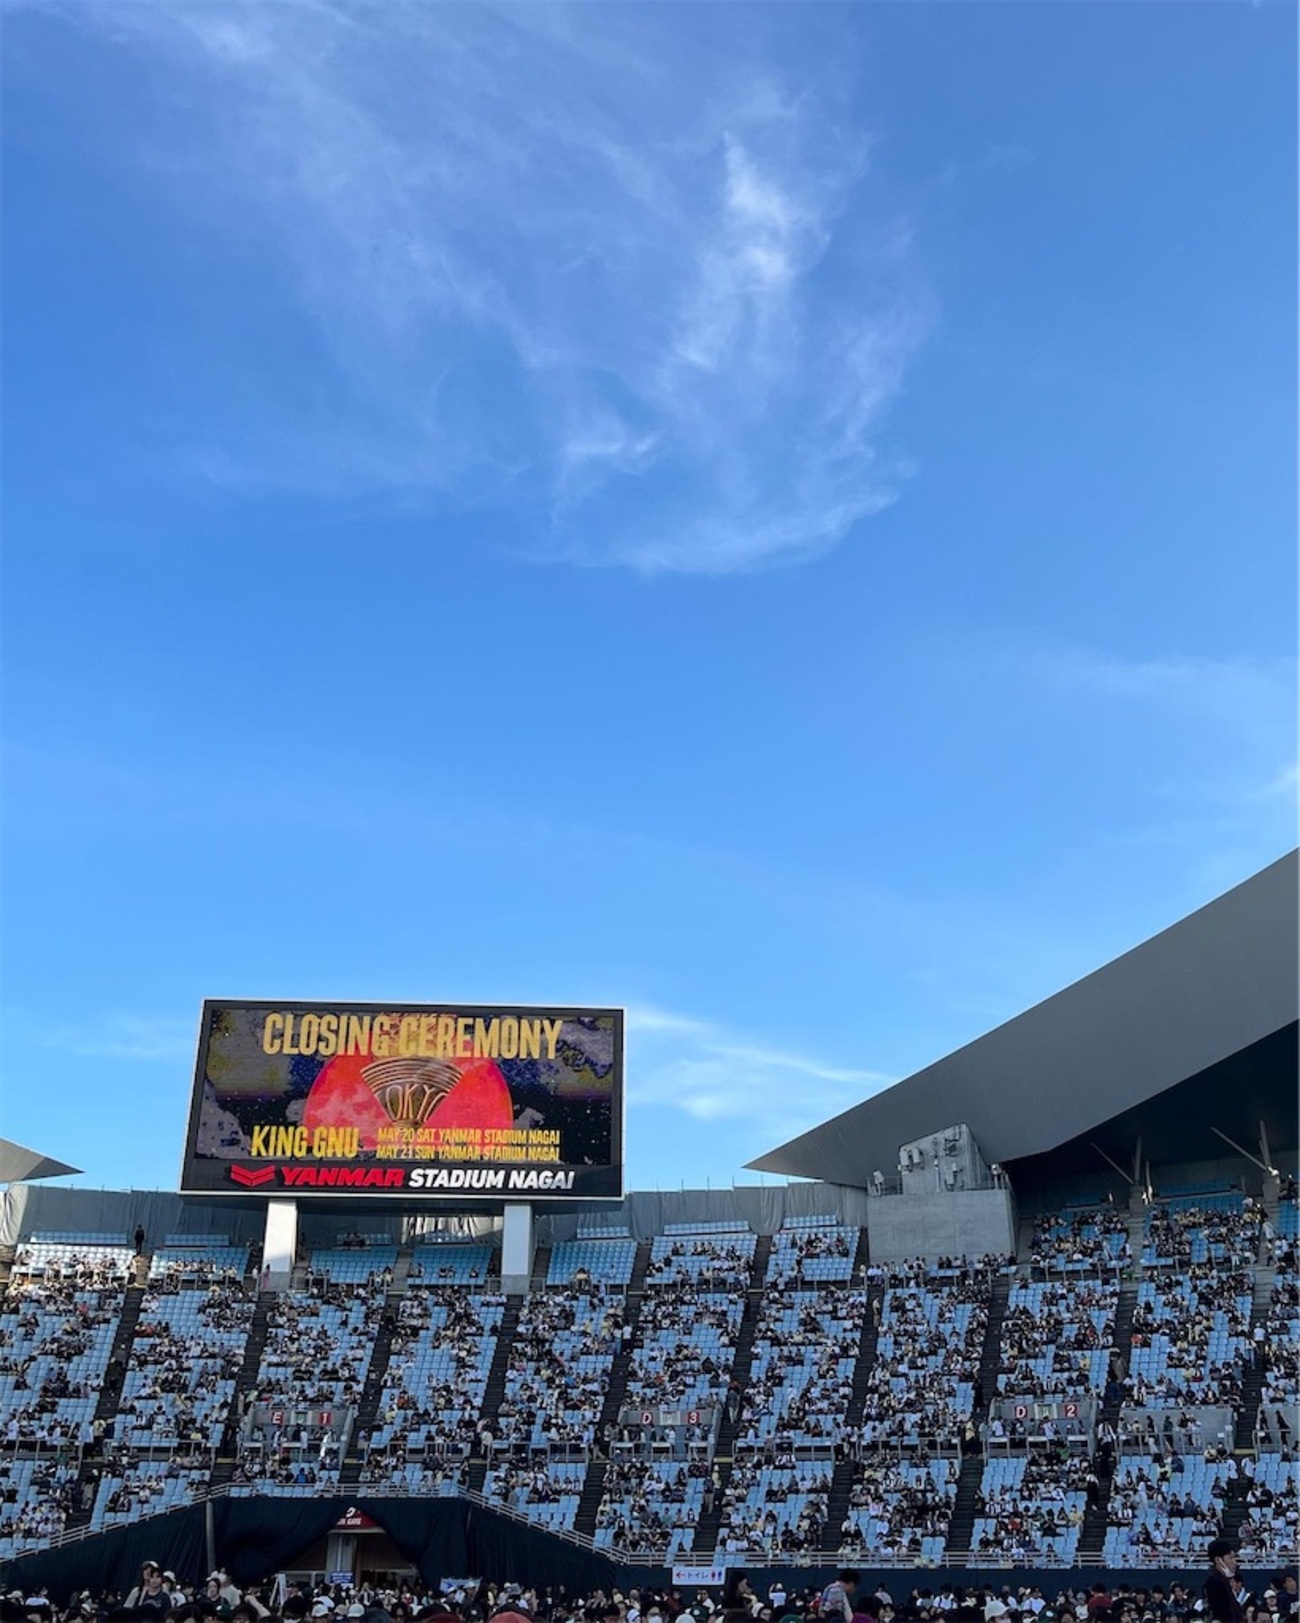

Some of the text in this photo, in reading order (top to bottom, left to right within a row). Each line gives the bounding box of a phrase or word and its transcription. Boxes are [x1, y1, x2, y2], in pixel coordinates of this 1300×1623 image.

[263, 1012, 563, 1060] CLOSING CEREMONY
[250, 1125, 359, 1158] KING GNU
[377, 1128, 561, 1145] MAY 20 SAT YANMAR STADIUM NAGAI
[375, 1145, 398, 1159] MAY
[414, 1146, 435, 1160] SUN
[438, 1145, 481, 1161] YANMAR
[482, 1146, 527, 1161] STADIUM
[528, 1147, 560, 1162] NAGAI
[281, 1166, 575, 1190] YANMAR STADIUM NAGAI
[272, 1411, 283, 1424] E
[642, 1412, 698, 1424] D 3
[1015, 1405, 1076, 1418] D 2
